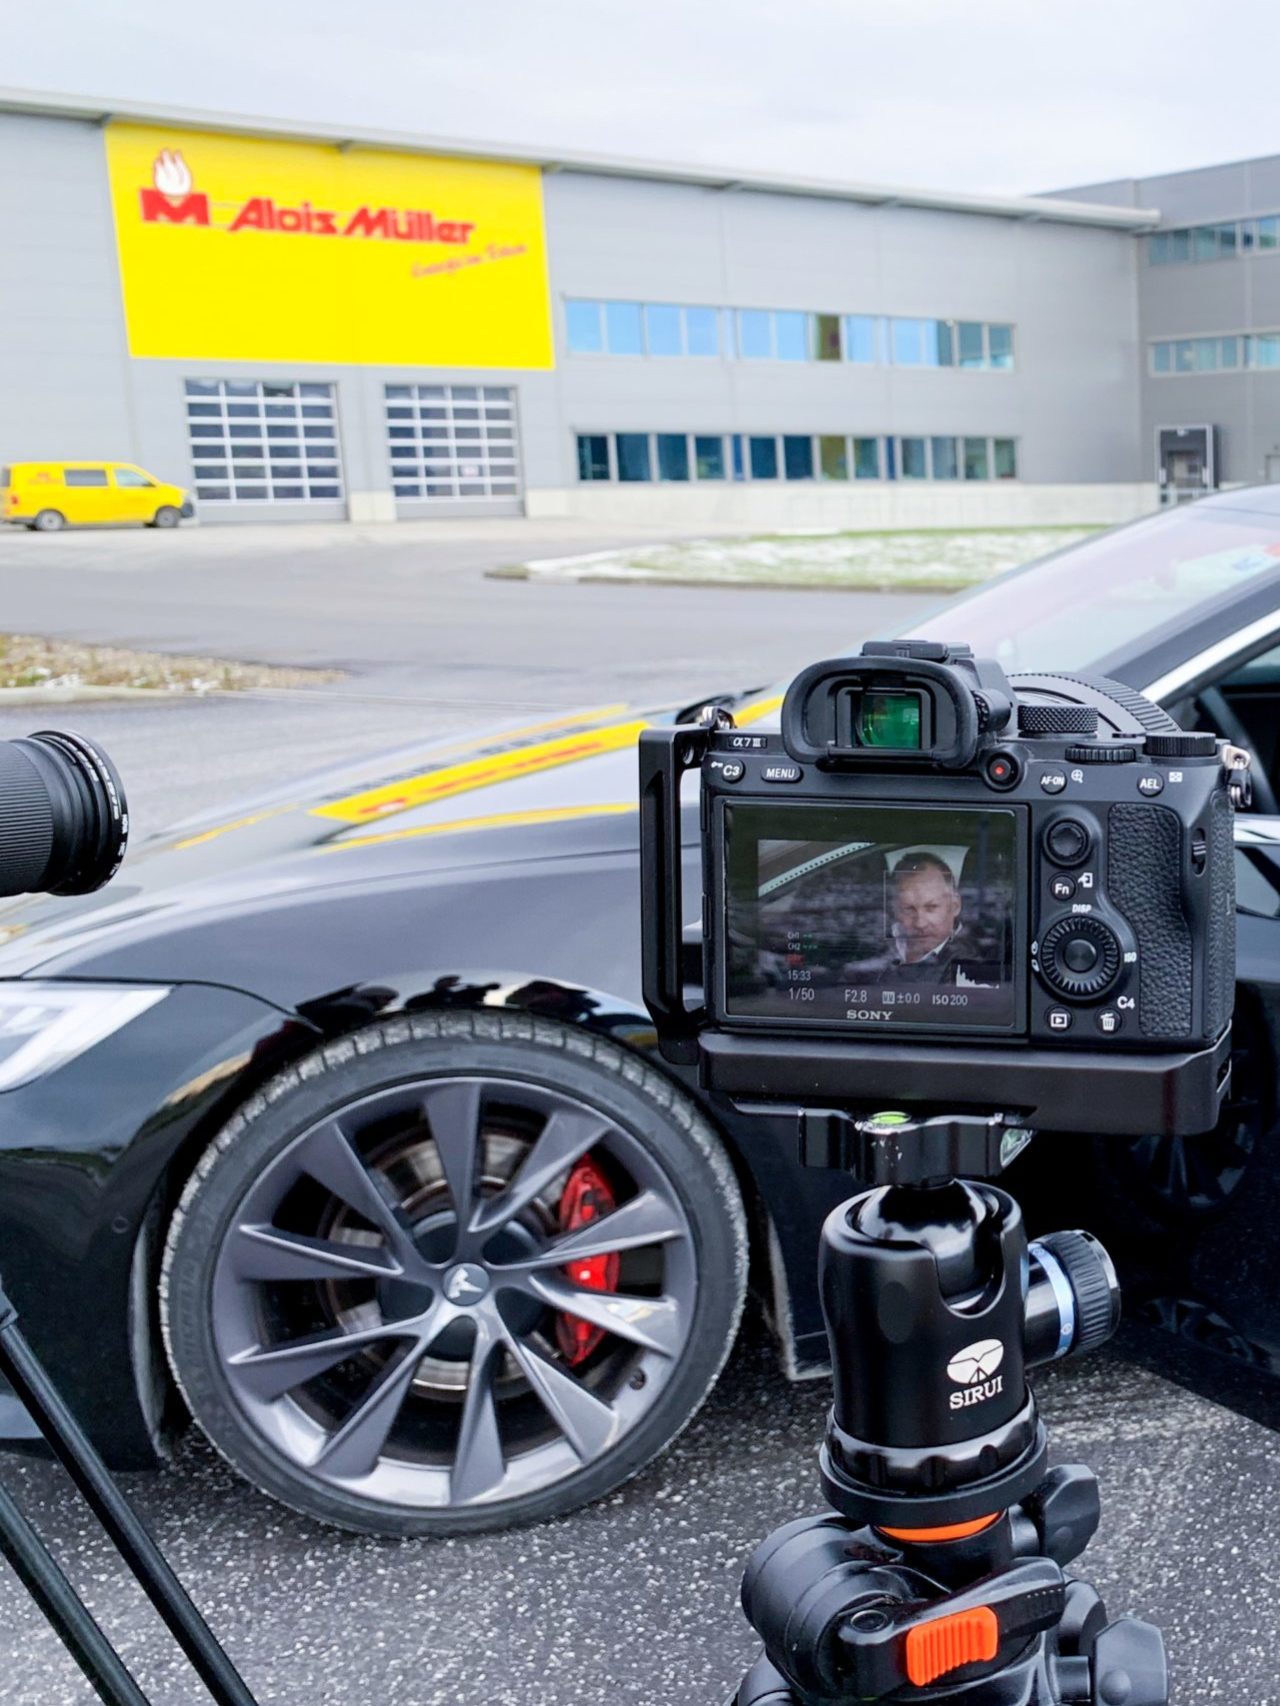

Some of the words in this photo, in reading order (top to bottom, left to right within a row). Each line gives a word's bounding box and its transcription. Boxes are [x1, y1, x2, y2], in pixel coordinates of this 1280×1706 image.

[227, 197, 338, 235] Alois
[343, 206, 474, 244] Müller
[723, 765, 740, 776] C3
[766, 768, 795, 778] MENU
[1140, 778, 1159, 789] AEL
[1055, 883, 1070, 895] Fn
[1072, 903, 1092, 913] DISP
[1123, 952, 1137, 962] ISO
[789, 987, 815, 1001] 1/50
[844, 989, 868, 1003] F2.8
[1117, 996, 1135, 1009] C4
[846, 1009, 893, 1020] SONY
[949, 1375, 1003, 1410] SIRUI
